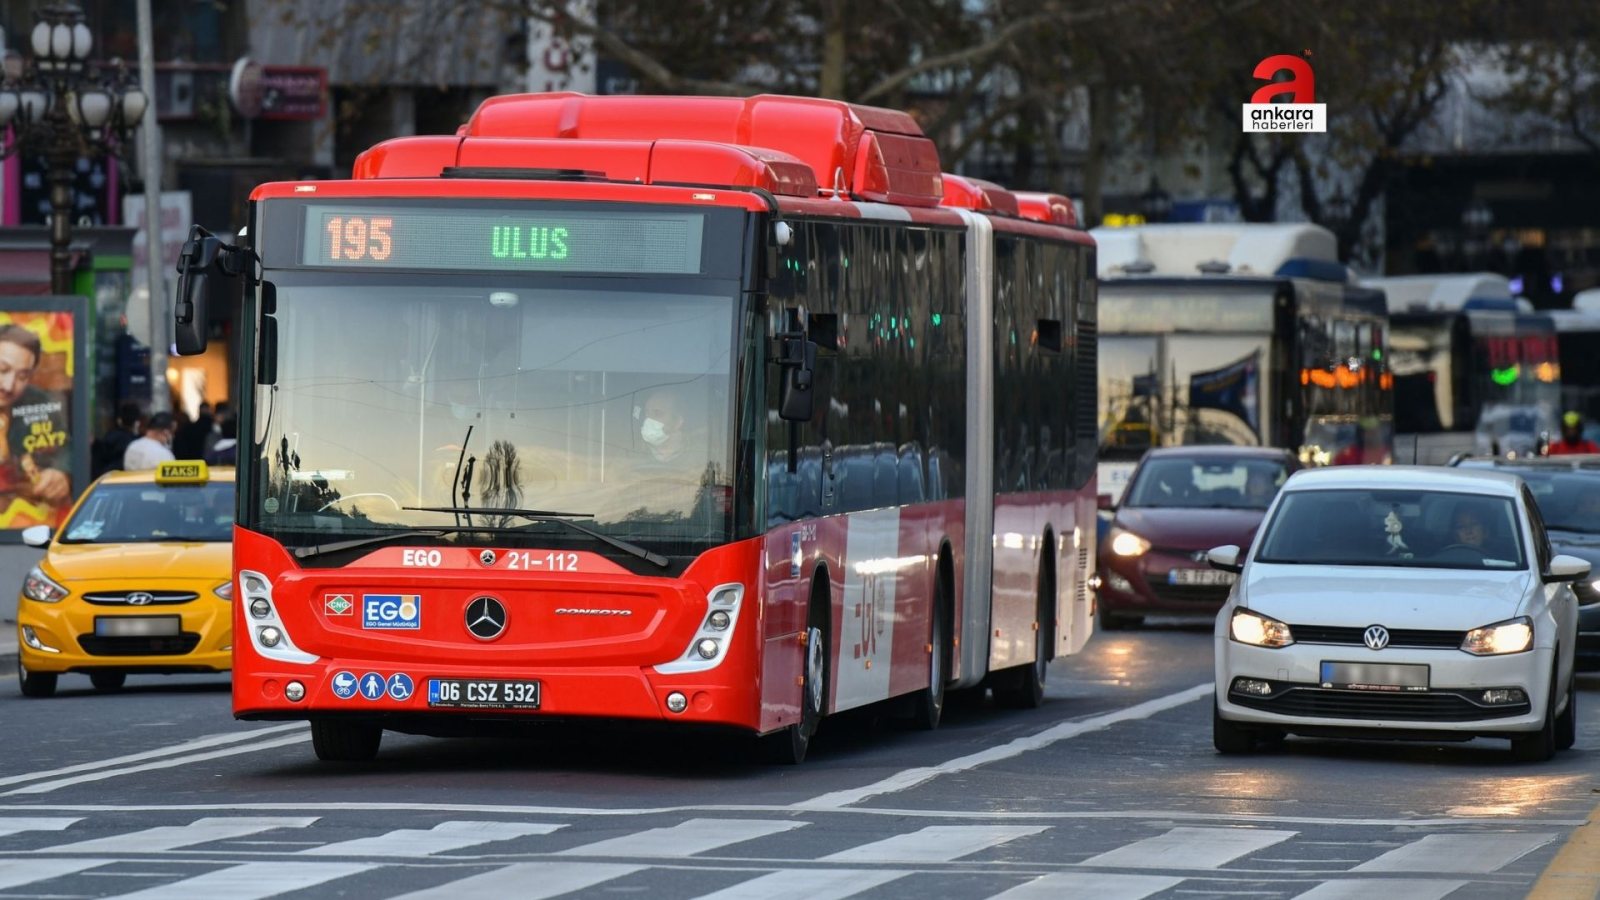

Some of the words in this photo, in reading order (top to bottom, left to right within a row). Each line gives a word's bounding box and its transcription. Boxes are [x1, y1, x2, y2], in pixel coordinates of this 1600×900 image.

[327, 216, 393, 261] 195
[492, 225, 569, 260] ULUS
[31, 420, 53, 436] BU
[23, 430, 66, 454] ÇAY?
[402, 549, 442, 567] EGO
[507, 551, 578, 572] 21-112
[330, 600, 348, 609] CNG
[366, 601, 417, 621] EGO
[440, 682, 460, 701] 06
[467, 683, 498, 702] CSZ
[504, 683, 535, 702] 532
